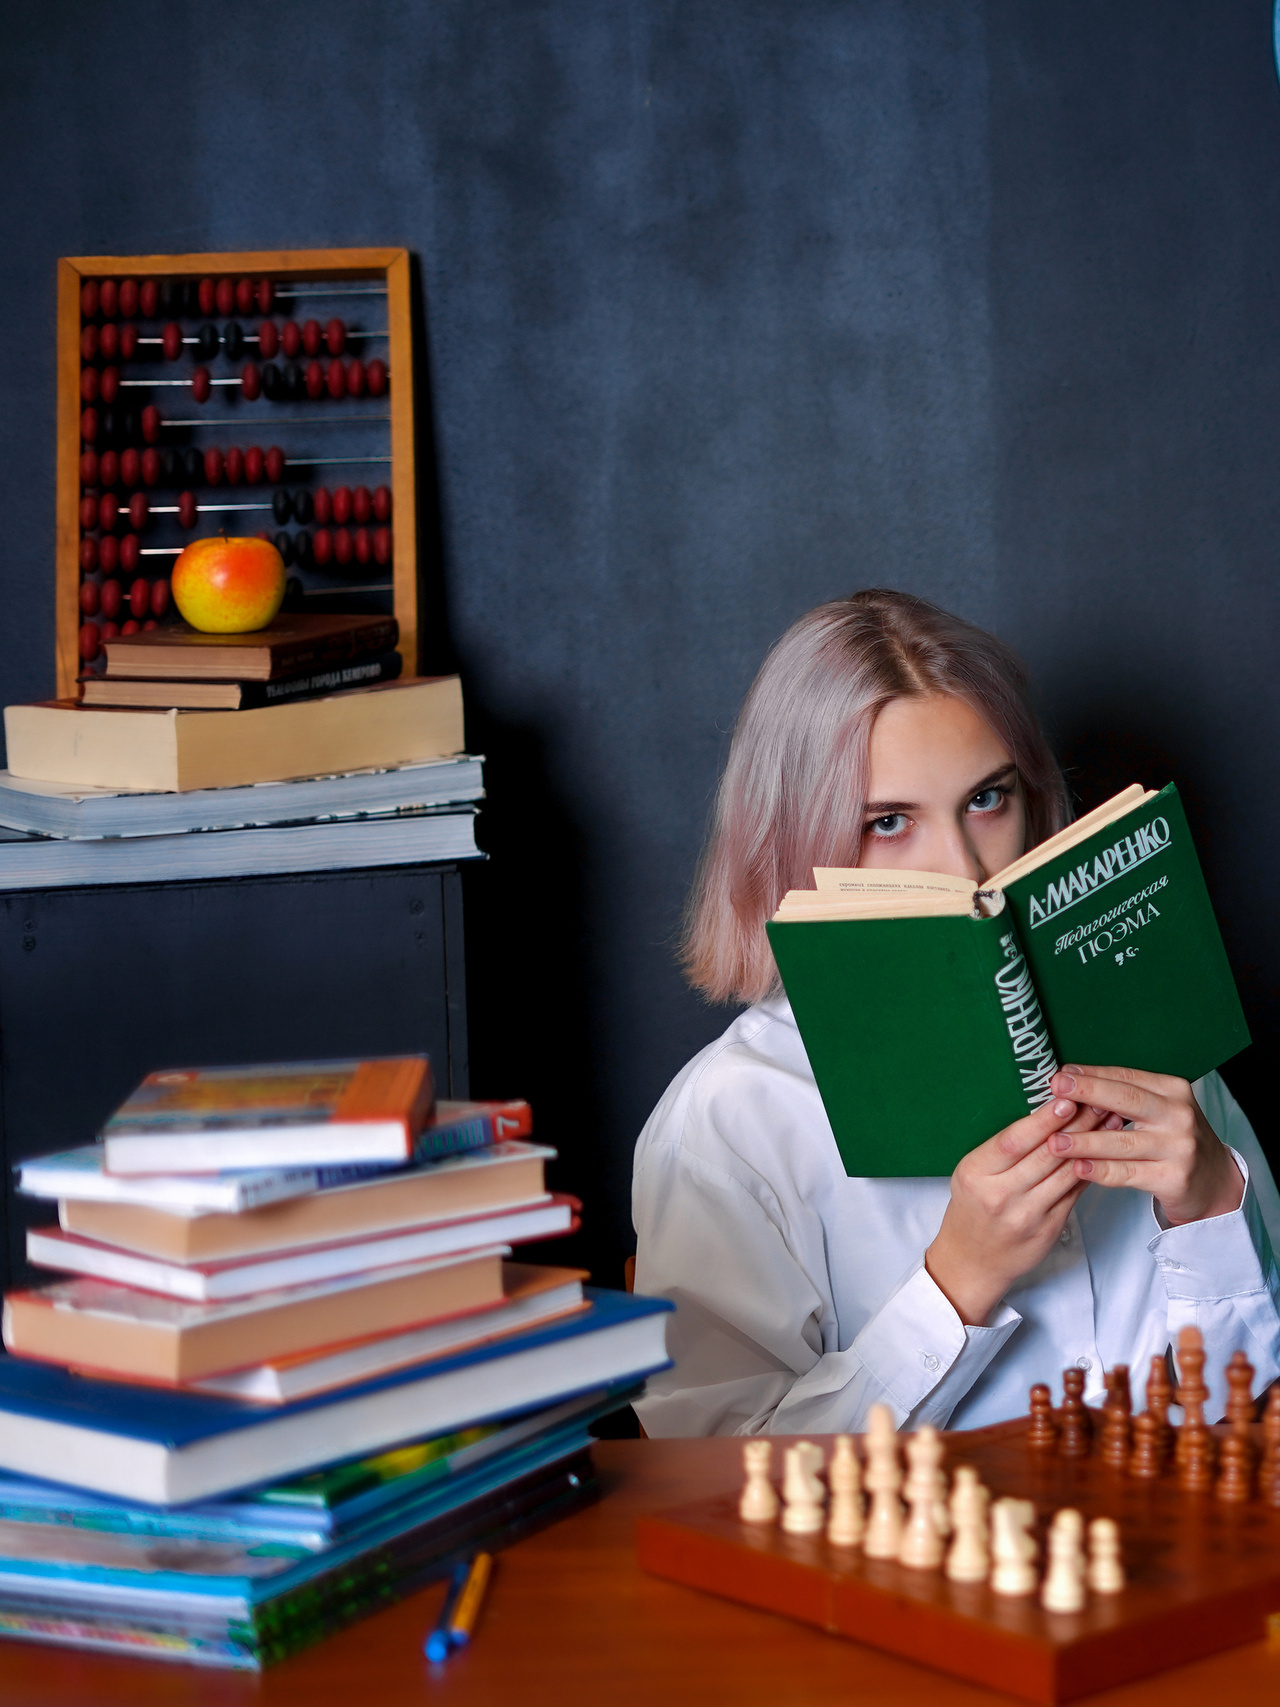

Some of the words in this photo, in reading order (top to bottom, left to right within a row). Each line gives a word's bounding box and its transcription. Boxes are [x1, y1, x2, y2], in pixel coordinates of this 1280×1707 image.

[311, 671, 341, 688] ГОРОДА
[839, 882, 864, 891] скромных
[1054, 875, 1169, 955] Педагогическая
[1077, 902, 1161, 964] ПОЭМА
